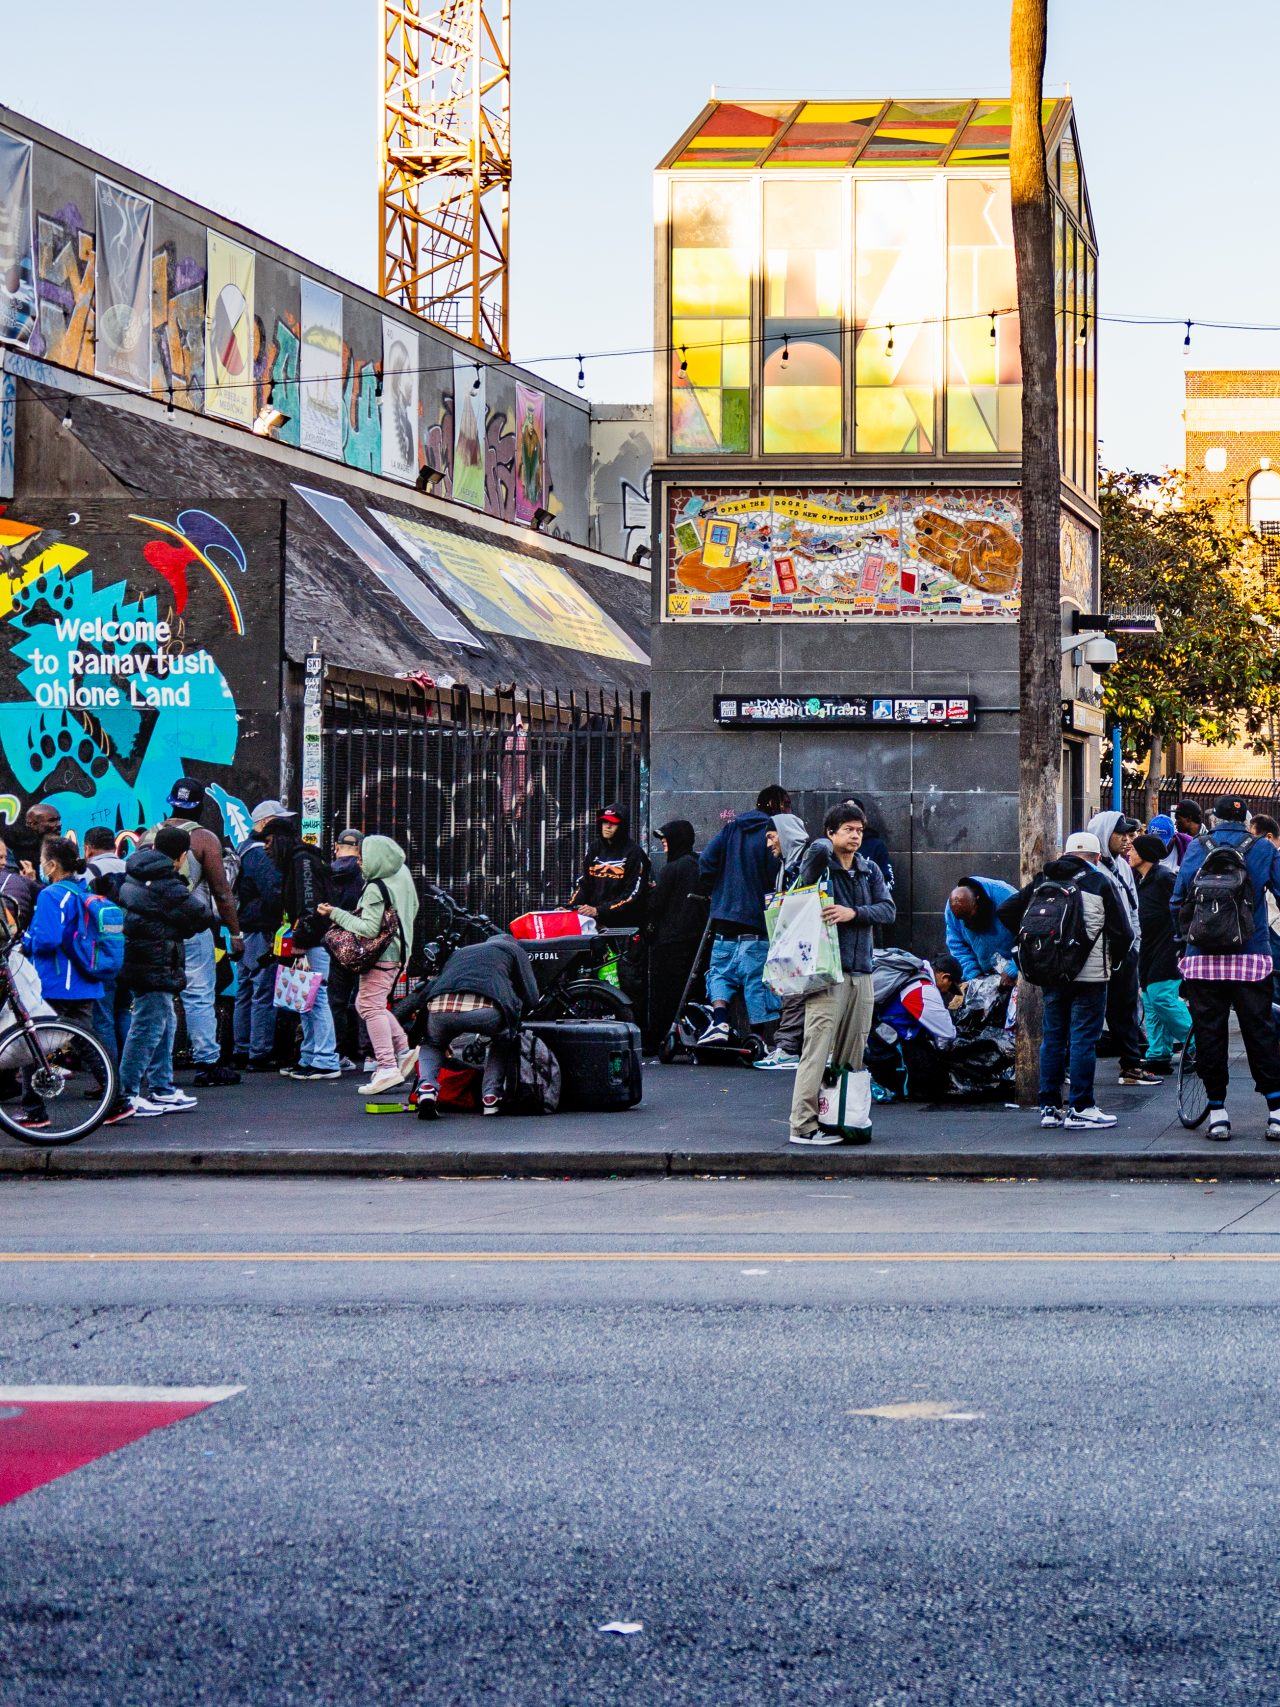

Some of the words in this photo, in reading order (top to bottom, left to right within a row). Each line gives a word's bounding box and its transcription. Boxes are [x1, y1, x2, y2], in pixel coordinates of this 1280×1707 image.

[721, 503, 747, 513] OPEN
[775, 500, 808, 509] DOORS
[821, 509, 884, 522] OPPORTUNITIES
[55, 617, 171, 642] Welcome
[27, 648, 59, 675] to
[68, 647, 215, 682] Ramaytush
[35, 679, 120, 706] Ohlone
[130, 680, 190, 706] Land
[90, 809, 111, 824] FTP
[303, 860, 314, 904] MICHAEL
[534, 952, 559, 960] PEDAL
